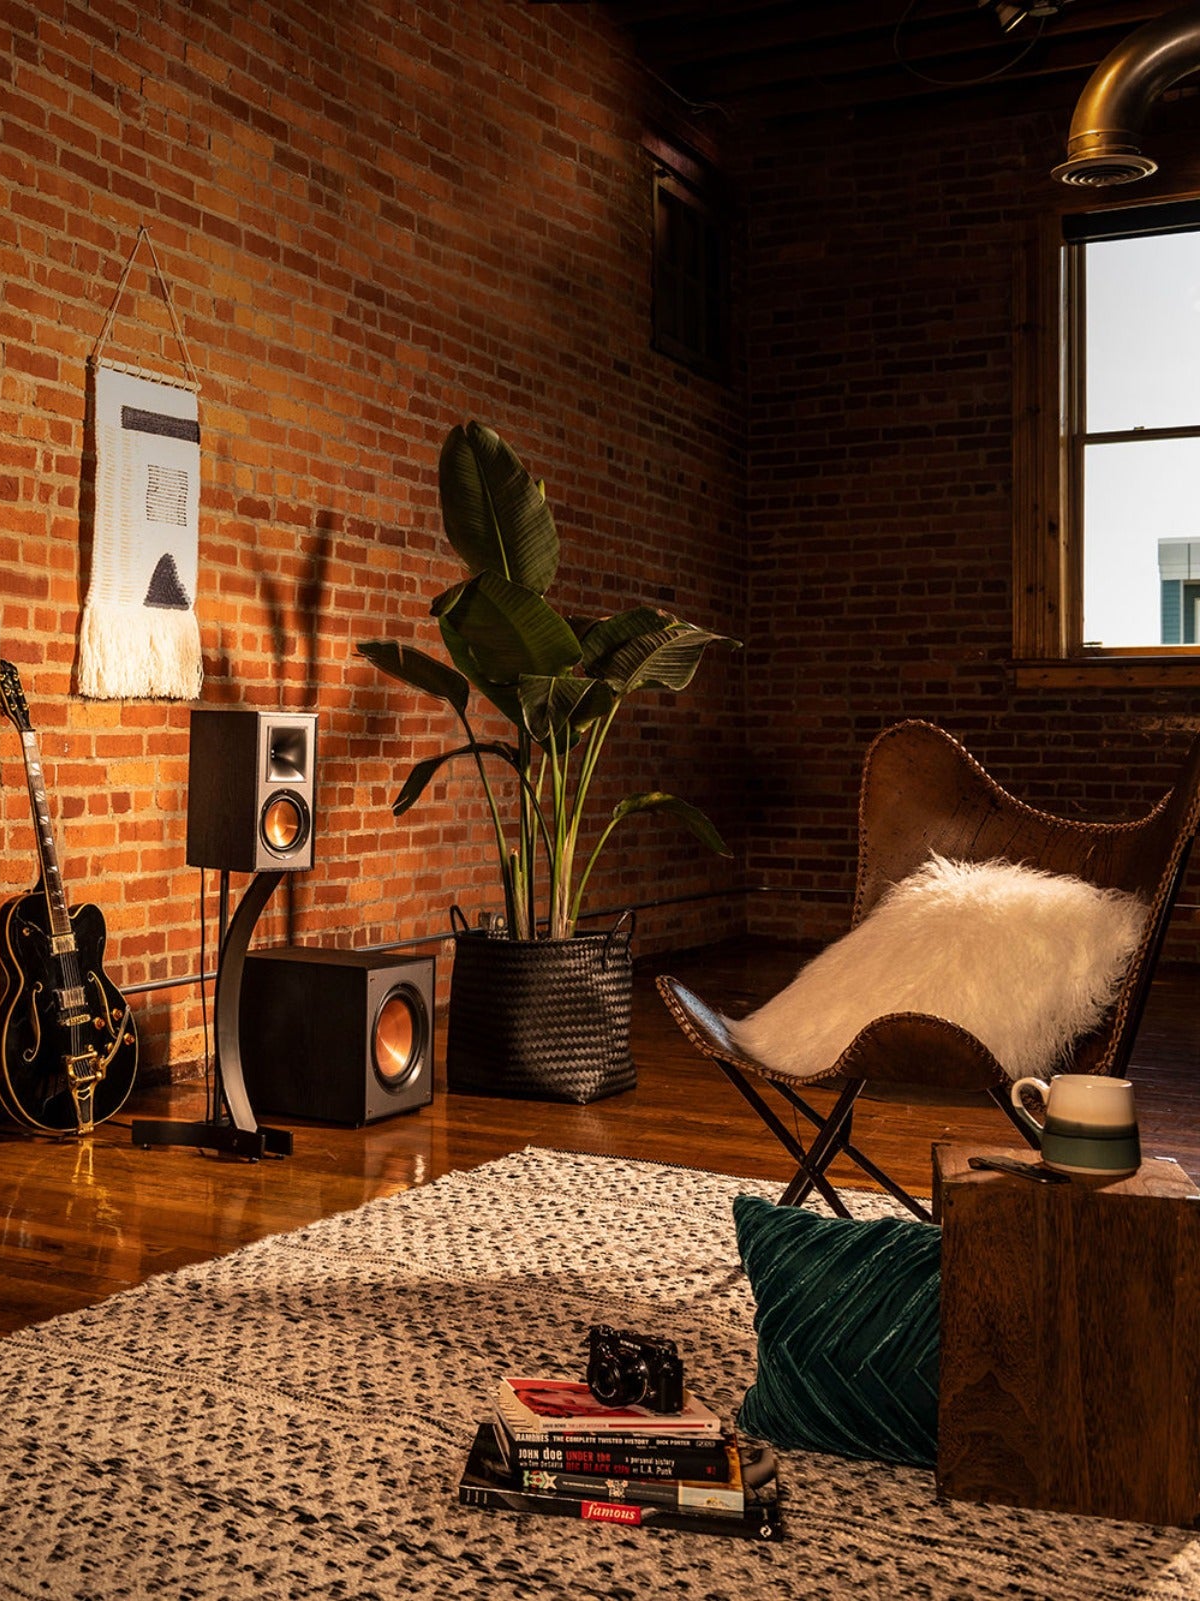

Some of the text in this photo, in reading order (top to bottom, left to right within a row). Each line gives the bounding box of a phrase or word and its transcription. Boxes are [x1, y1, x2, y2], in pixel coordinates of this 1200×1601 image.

[515, 1433, 549, 1442] RAMONES
[553, 1435, 564, 1443] THE
[565, 1436, 596, 1444] COMPLETE
[519, 1448, 539, 1459] JOHN
[543, 1447, 563, 1460] doe
[565, 1450, 594, 1462] UNDER
[630, 1457, 653, 1465] personal
[565, 1462, 580, 1471] BIG
[583, 1462, 611, 1473] BLACK
[613, 1464, 631, 1474] SUN
[583, 1502, 637, 1520] famous
